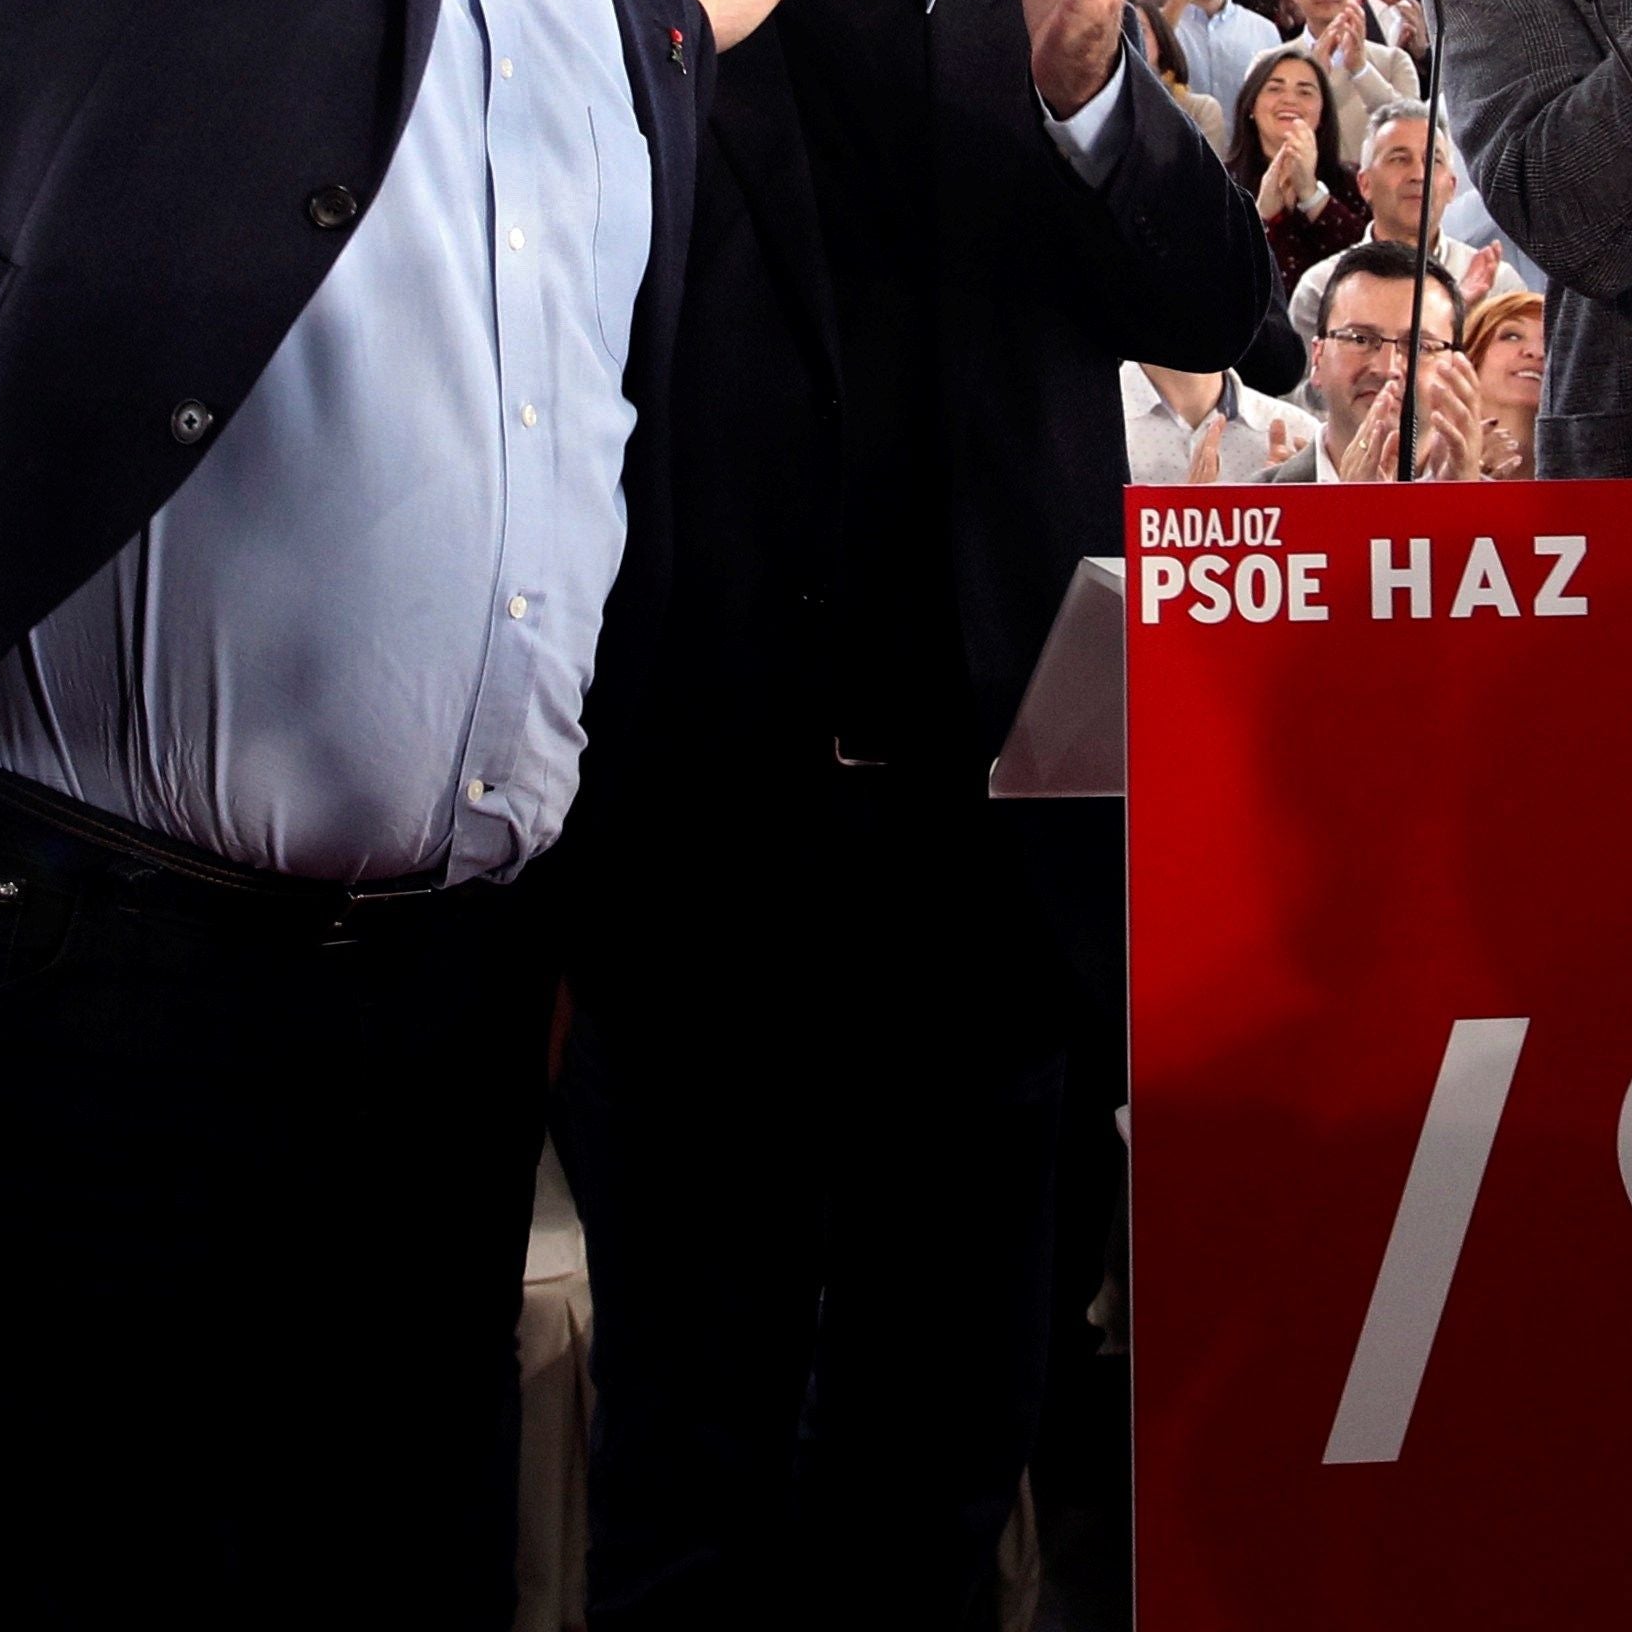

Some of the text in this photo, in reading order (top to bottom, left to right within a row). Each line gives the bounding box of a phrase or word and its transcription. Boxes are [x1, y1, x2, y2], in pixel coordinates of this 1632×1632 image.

[1140, 507, 1282, 549] BADAJOZ
[1141, 553, 1329, 624] PSOE
[1370, 535, 1589, 620] HAZ
